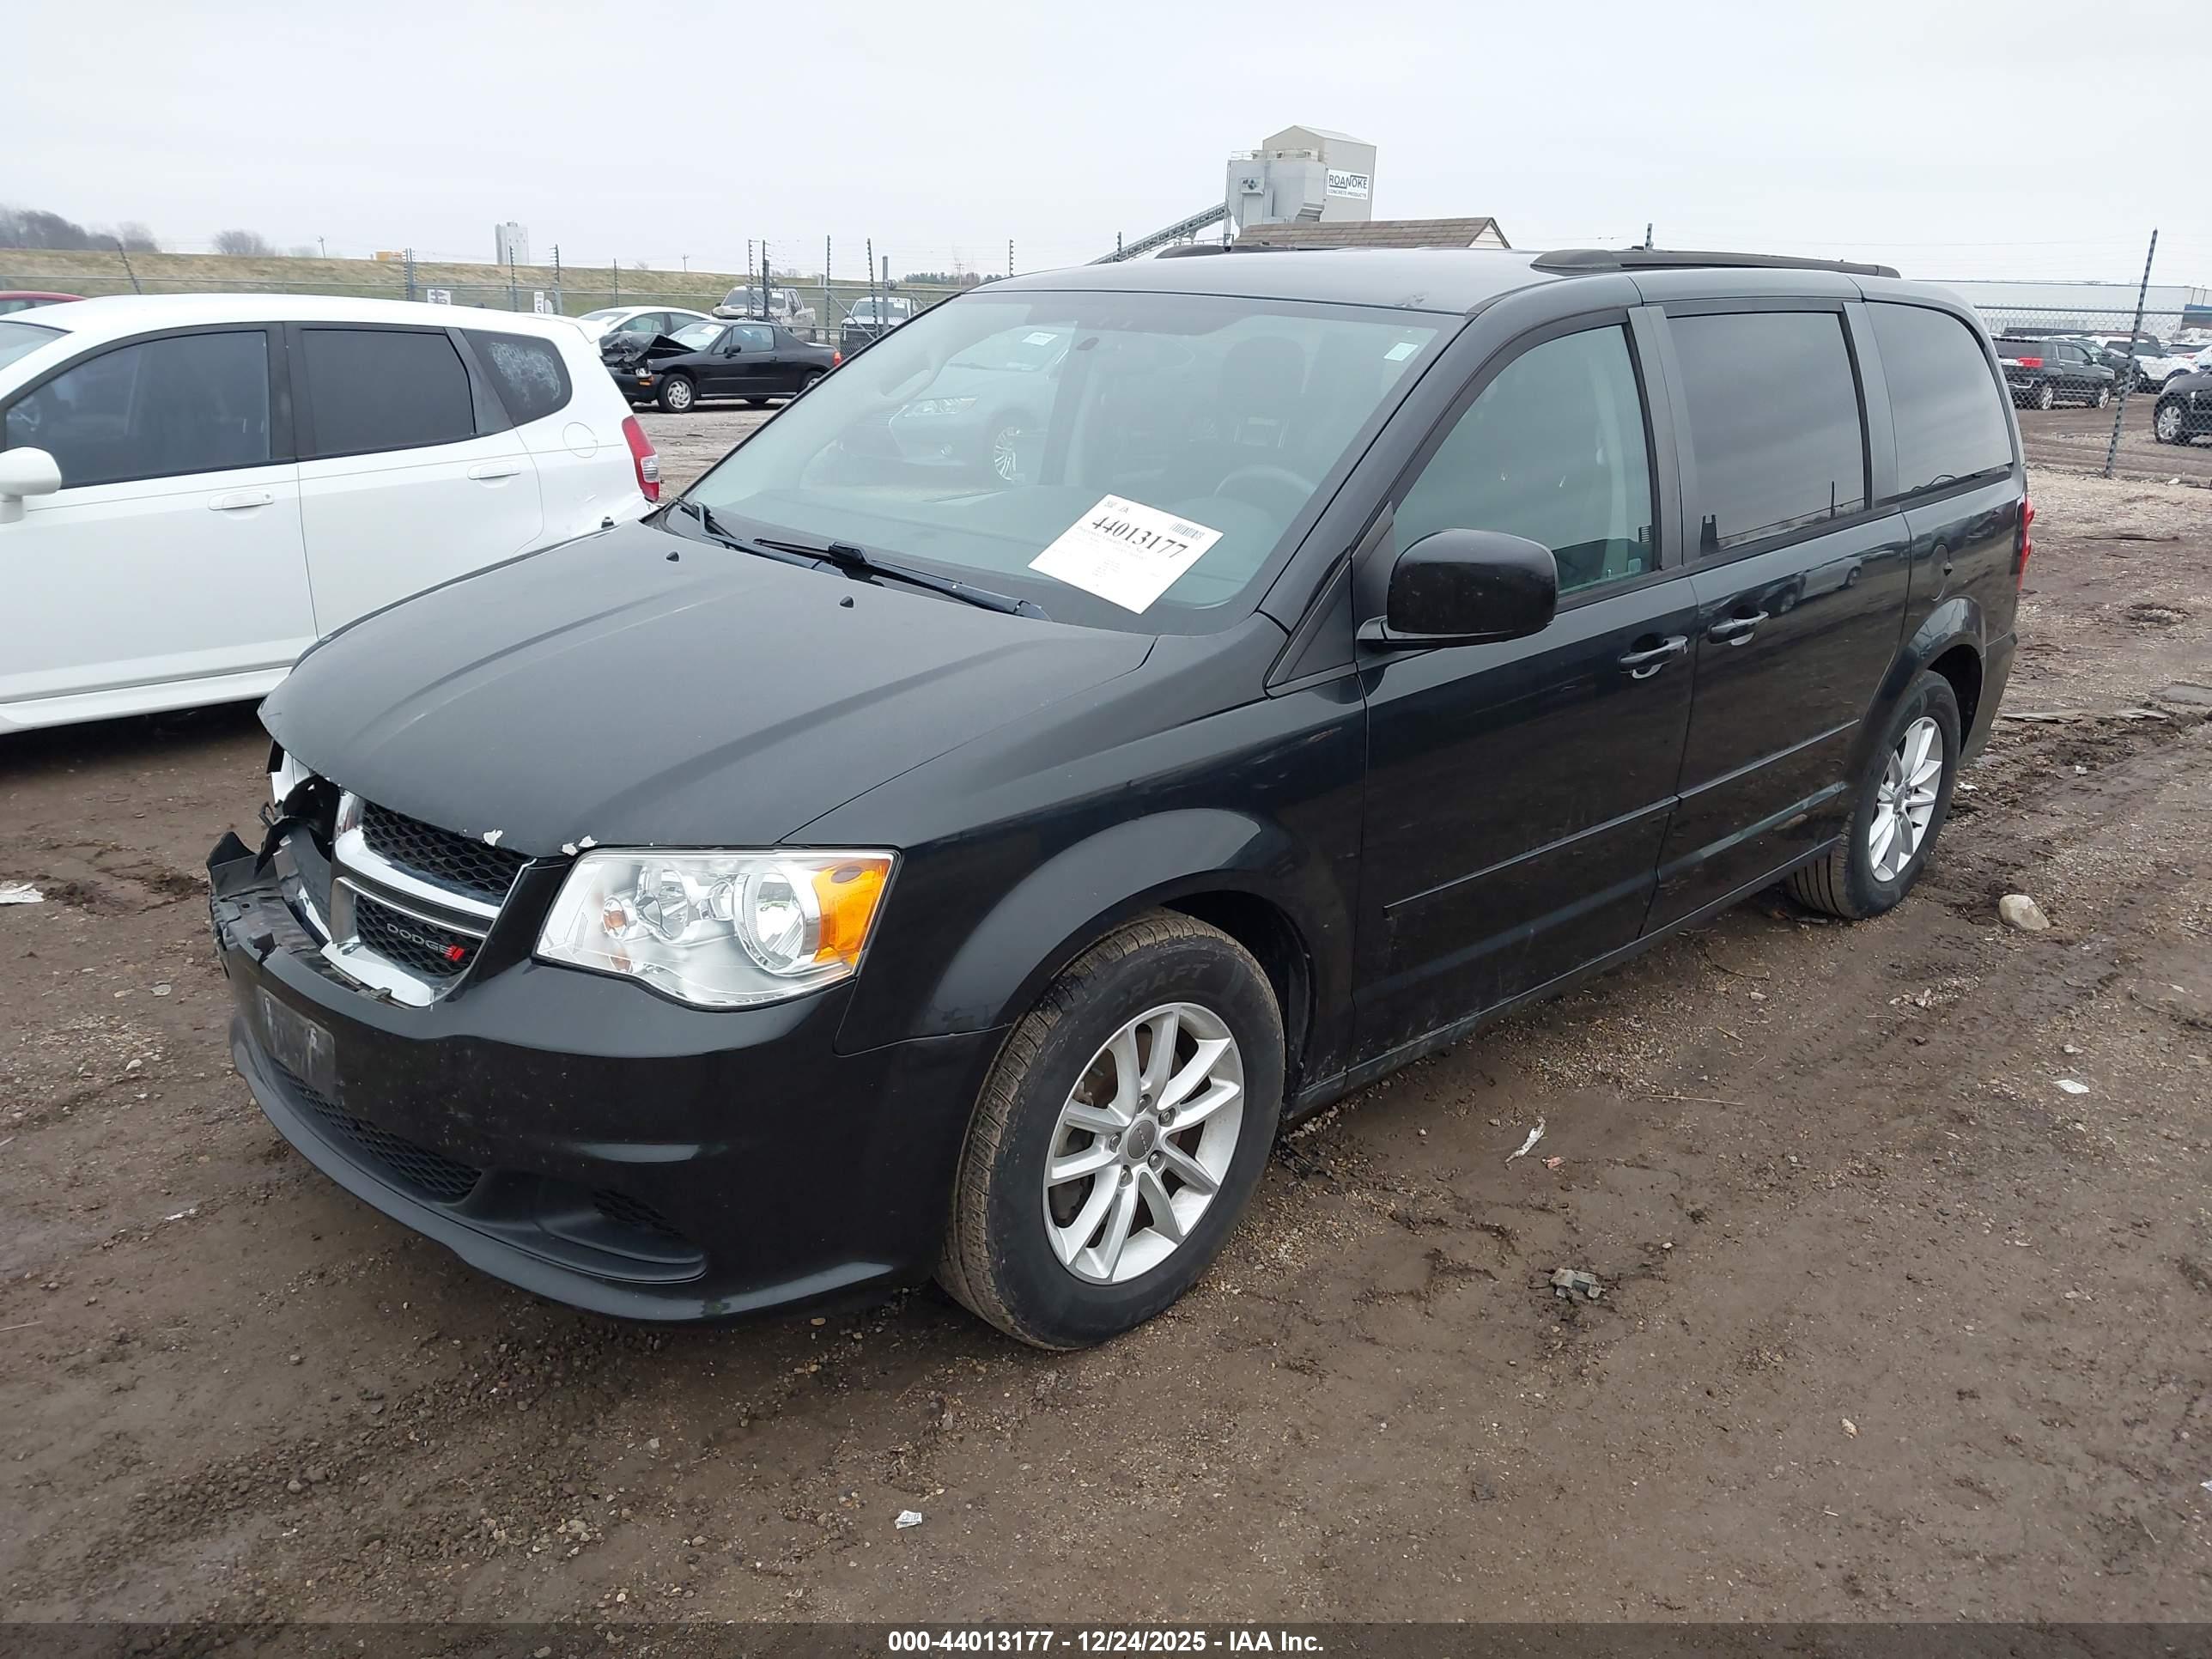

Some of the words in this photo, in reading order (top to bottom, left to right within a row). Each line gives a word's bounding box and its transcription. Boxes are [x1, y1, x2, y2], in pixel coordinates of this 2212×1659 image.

[1329, 174, 1367, 189] ROANOKE
[1092, 516, 1188, 558] 44013177
[386, 923, 453, 957] DODGE
